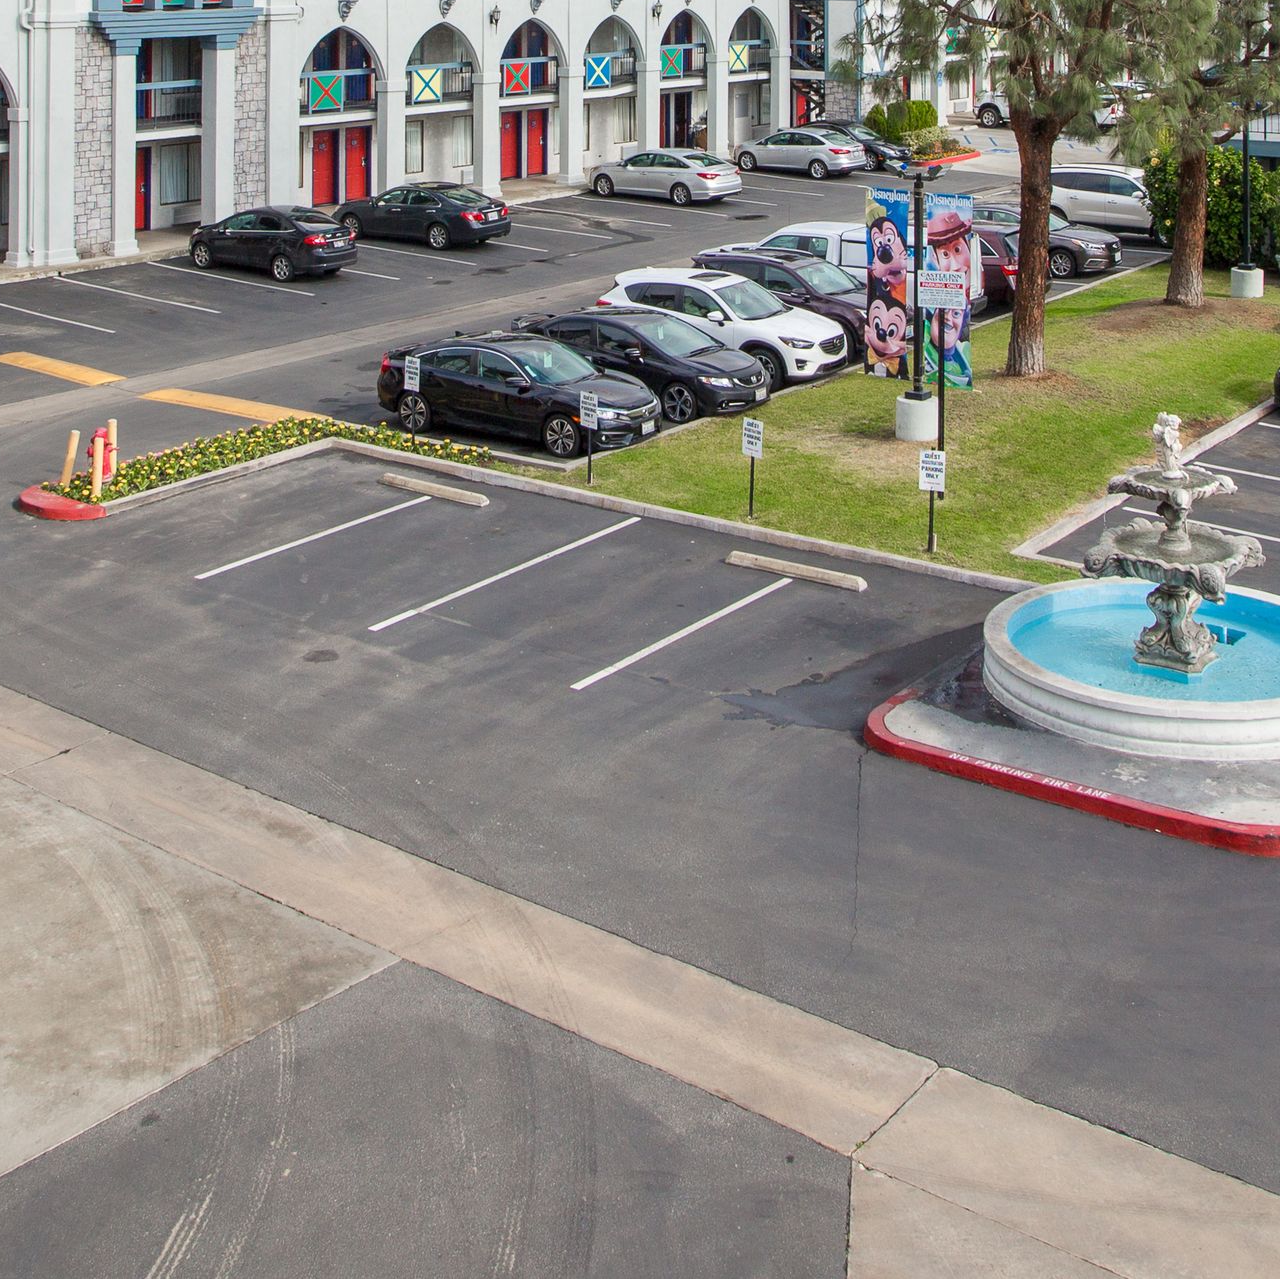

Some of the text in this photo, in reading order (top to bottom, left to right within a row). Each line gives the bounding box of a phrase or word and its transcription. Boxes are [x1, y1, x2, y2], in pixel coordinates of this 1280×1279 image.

[867, 187, 911, 203] Disneyland
[927, 192, 973, 207] Disneyland
[921, 466, 943, 474] PARKING
